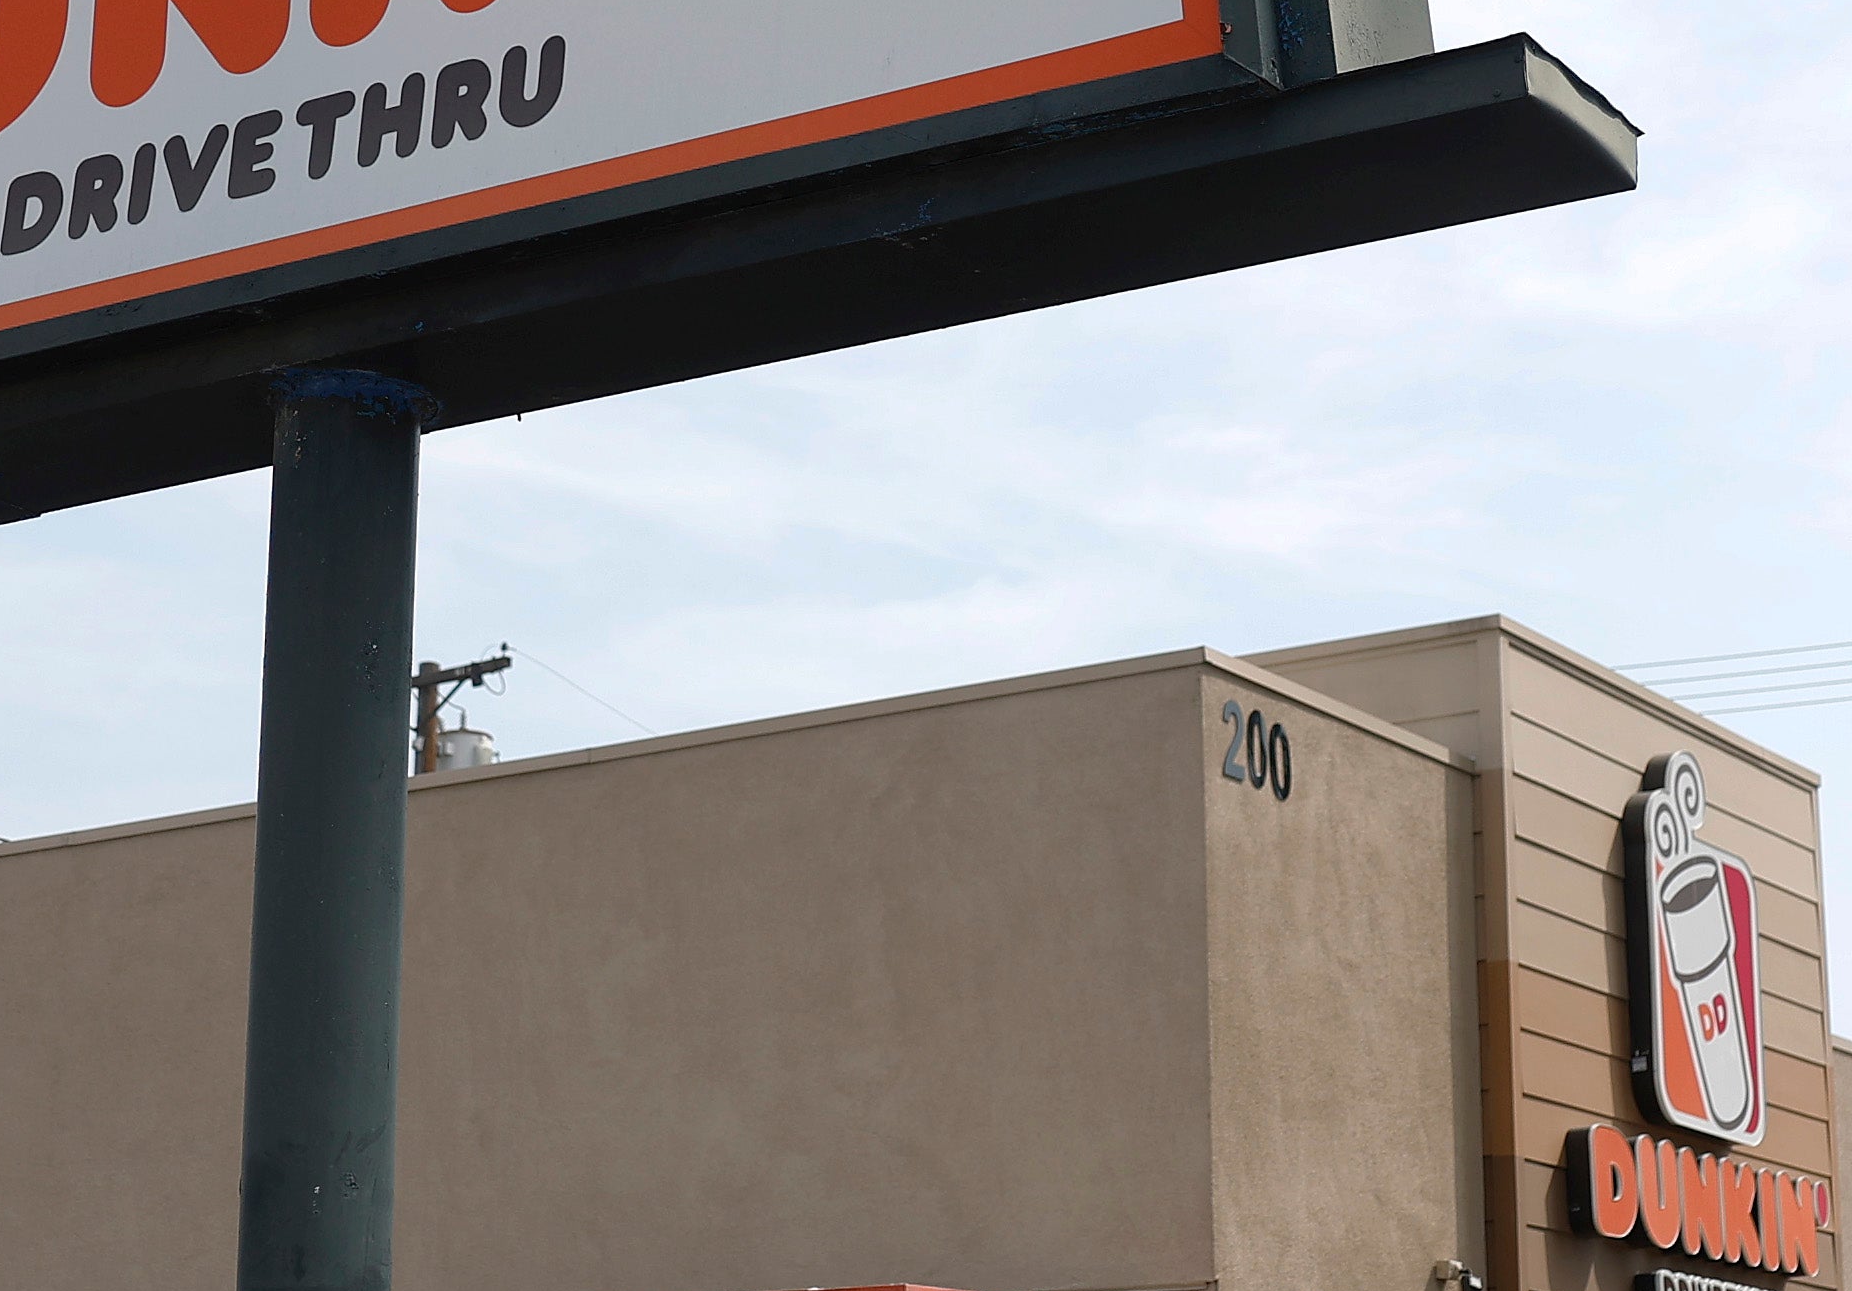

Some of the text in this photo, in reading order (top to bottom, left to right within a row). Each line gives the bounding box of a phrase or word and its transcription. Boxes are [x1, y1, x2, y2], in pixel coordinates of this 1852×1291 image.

[0, 35, 566, 257] DRIVE THRU
[1222, 700, 1292, 801] 200
[1697, 994, 1727, 1042] DD
[1588, 1123, 1829, 1277] DUNKIN'
